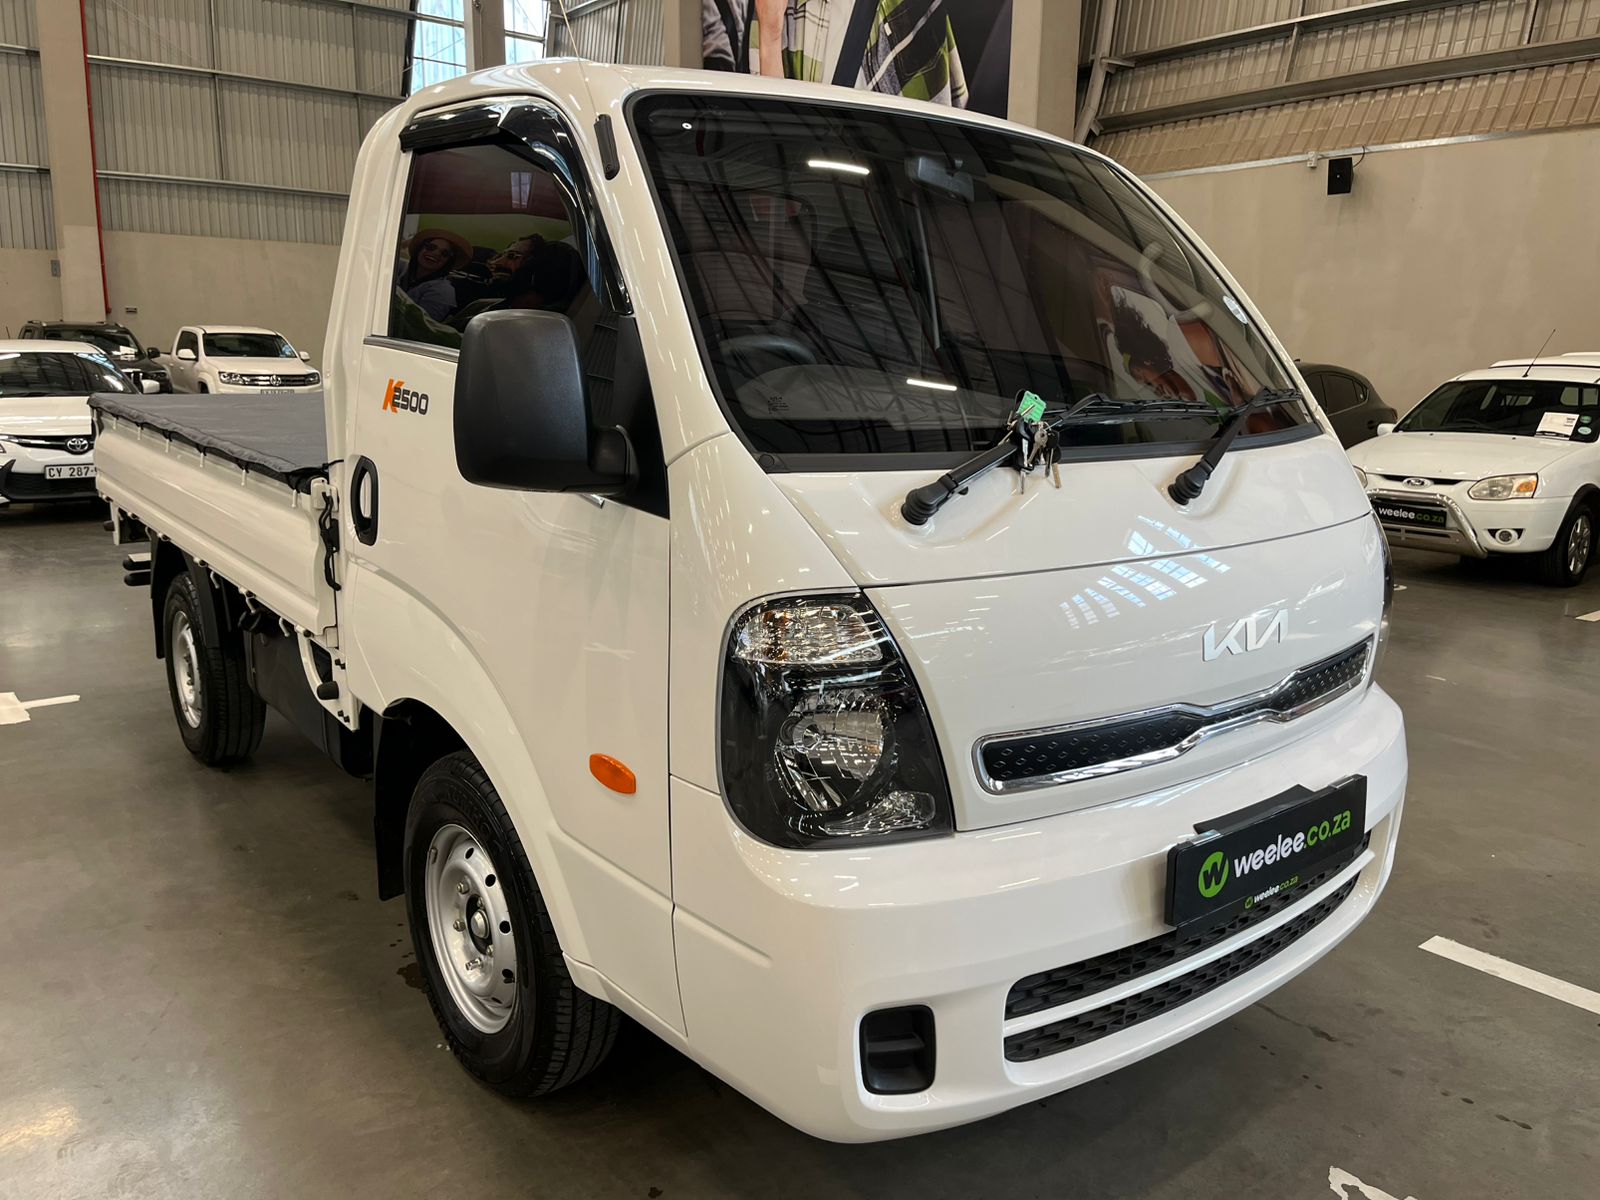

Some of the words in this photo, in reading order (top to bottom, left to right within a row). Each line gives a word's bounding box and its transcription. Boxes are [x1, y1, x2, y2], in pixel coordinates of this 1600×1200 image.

[382, 378, 429, 415] K2500
[48, 467, 62, 477] CY
[1202, 609, 1288, 661] KIA
[1234, 810, 1351, 878] weelee.co.za
